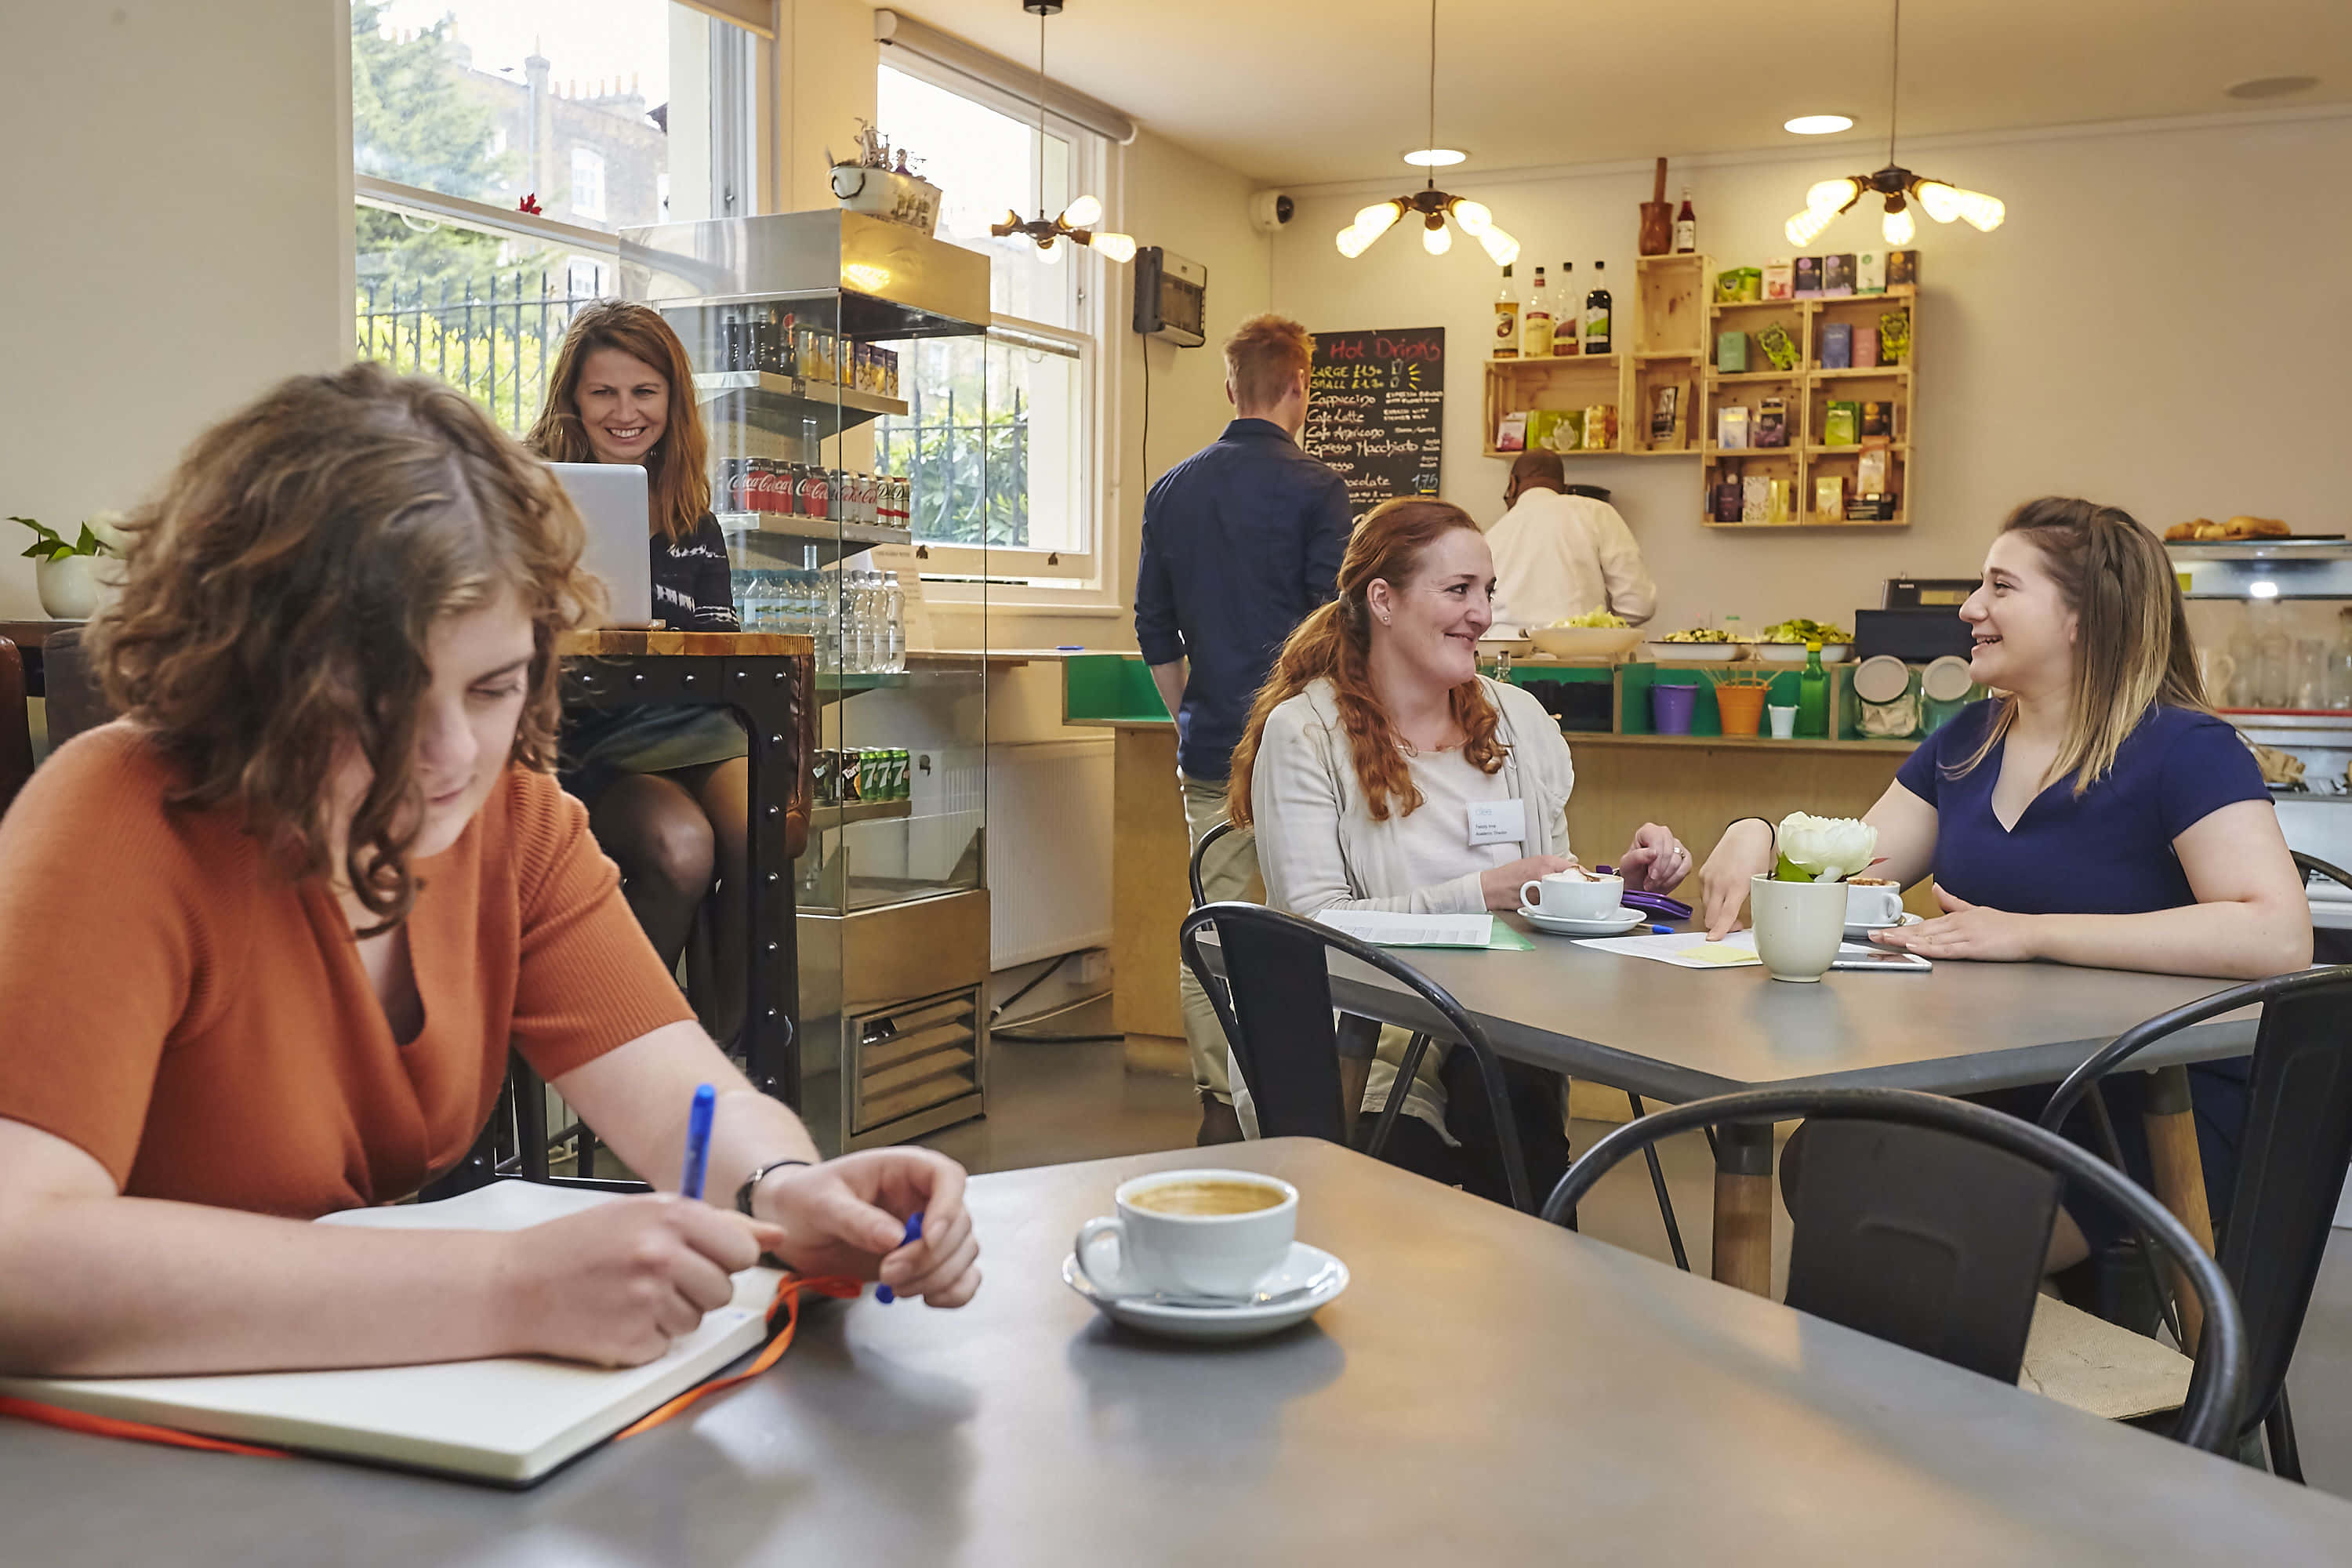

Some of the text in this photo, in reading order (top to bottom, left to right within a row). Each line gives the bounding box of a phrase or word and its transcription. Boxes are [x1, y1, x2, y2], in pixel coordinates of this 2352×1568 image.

[1330, 338, 1441, 361] Hot Drinks
[1311, 365, 1349, 378] LARGE
[1310, 379, 1346, 390] SMALL
[1308, 391, 1377, 408] Cappuccino
[1334, 408, 1365, 423] Latte
[1305, 440, 1352, 458] Espresso
[1356, 439, 1419, 458] Macchiato
